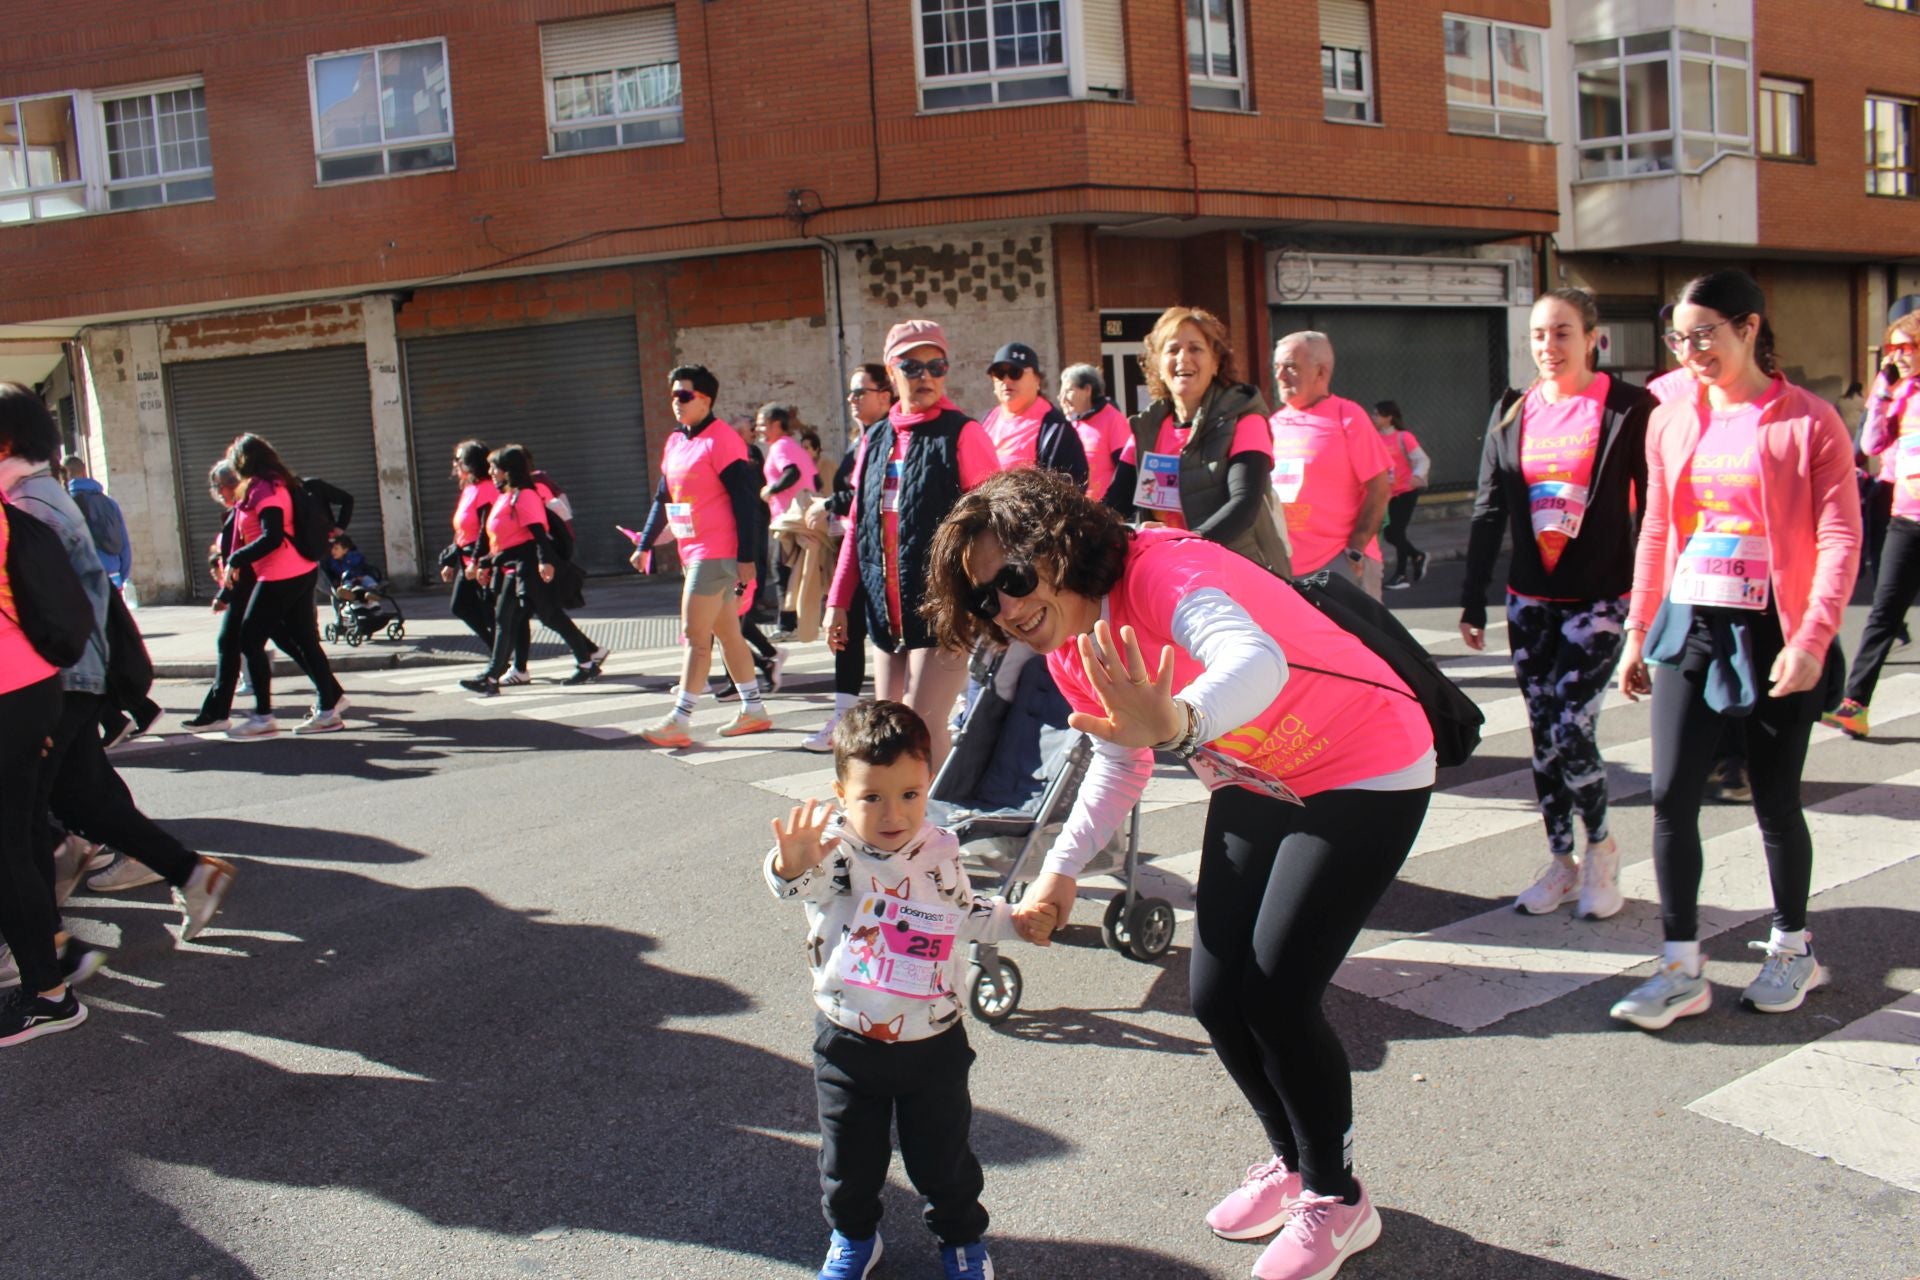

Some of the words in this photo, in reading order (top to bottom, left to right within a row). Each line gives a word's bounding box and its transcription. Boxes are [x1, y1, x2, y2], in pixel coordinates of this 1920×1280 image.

[1106, 321, 1122, 335] 20
[1535, 497, 1567, 510] 1219
[1704, 559, 1745, 577] 1216
[1277, 737, 1330, 777] ASANVI
[906, 935, 942, 958] 25
[876, 956, 895, 983] 11
